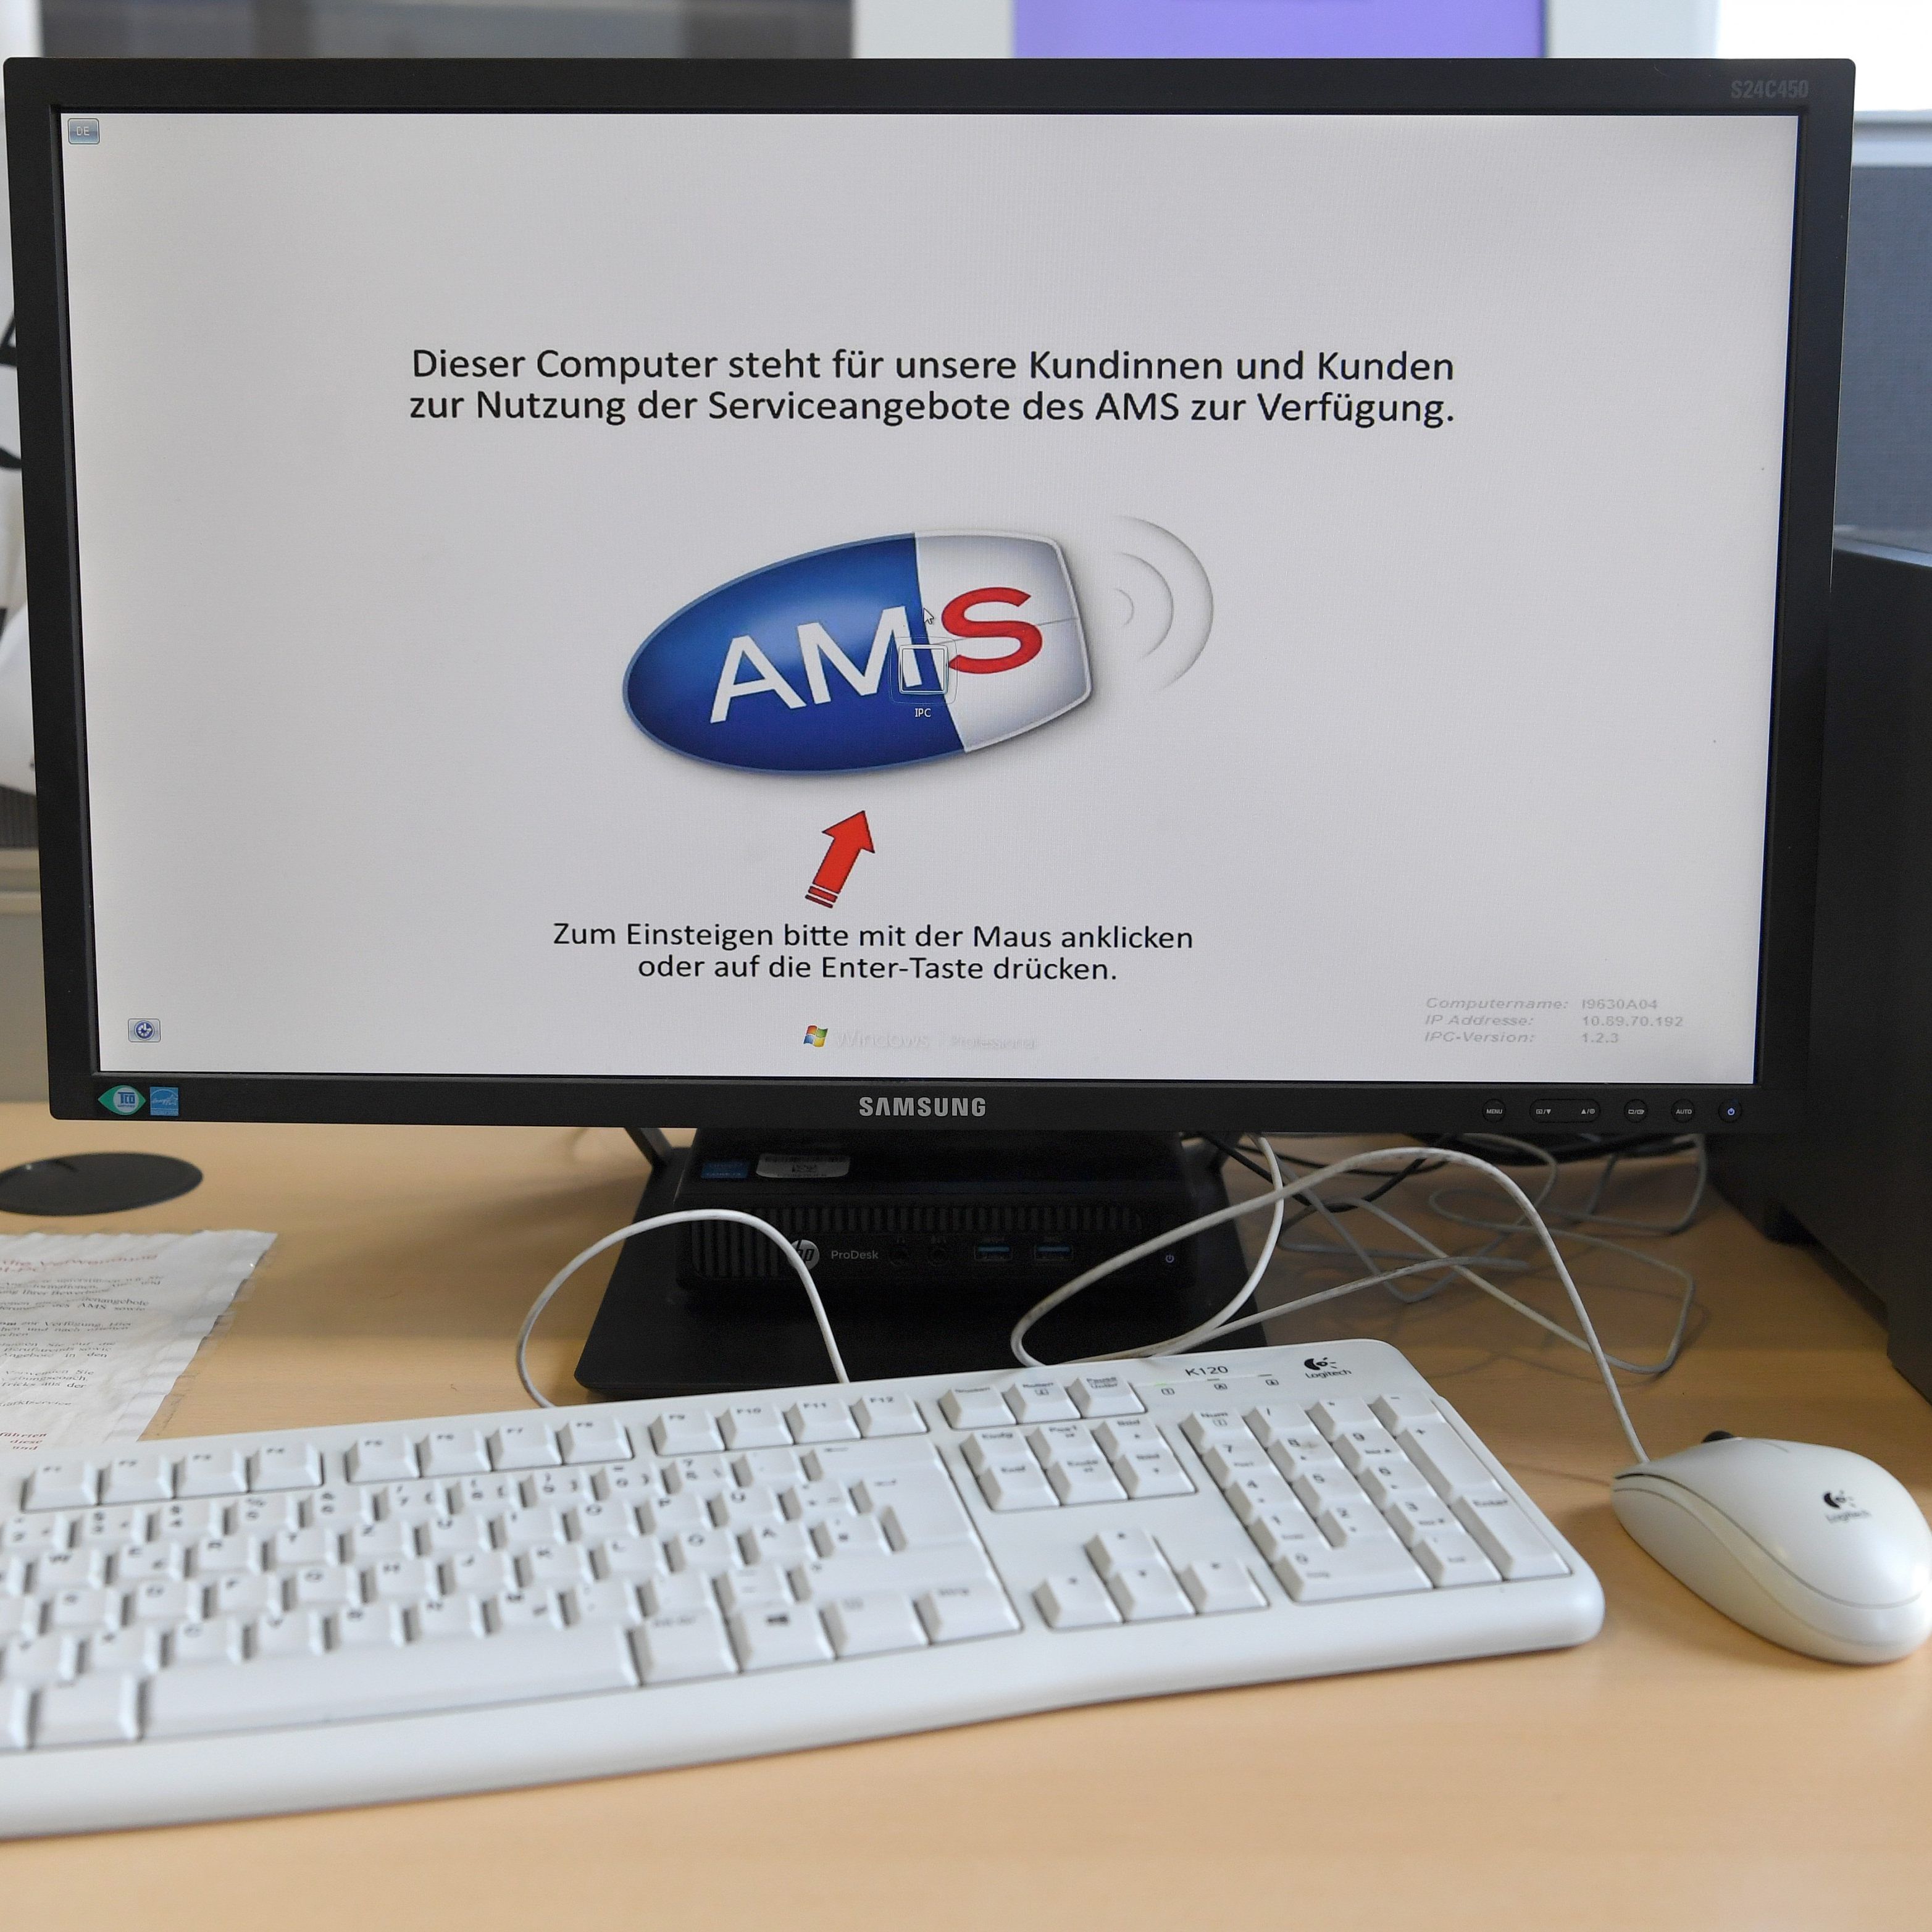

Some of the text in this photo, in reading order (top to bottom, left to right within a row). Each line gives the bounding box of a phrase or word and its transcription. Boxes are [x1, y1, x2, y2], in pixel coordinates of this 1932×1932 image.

[1731, 80, 1809, 99] S24C450
[76, 126, 90, 136] DE
[414, 349, 1452, 384] Dieser Computer steht für unsere Kundinnen und Kunden
[411, 390, 1453, 429] zur Nutzung der Serviceangebote des AMS zur Verfügung.
[709, 587, 1043, 724] AMS
[914, 708, 931, 717] IPC
[554, 923, 1192, 950] Zum Einsteigen bitte mit der Maus anklicken
[639, 955, 1116, 979] oder auf die Enter-Taste drücken.
[1426, 997, 1568, 1011] Computername:
[1425, 1014, 1444, 1025] IP
[1447, 1014, 1534, 1026] Addresse:
[1424, 1031, 1618, 1043] IPC-Version: 1.2.3
[117, 1092, 135, 1104] TCO
[859, 1096, 987, 1117] SAMSUNG
[831, 1250, 879, 1260] ProDesk
[1185, 1366, 1228, 1376] K120
[1305, 1369, 1352, 1379] Logitech
